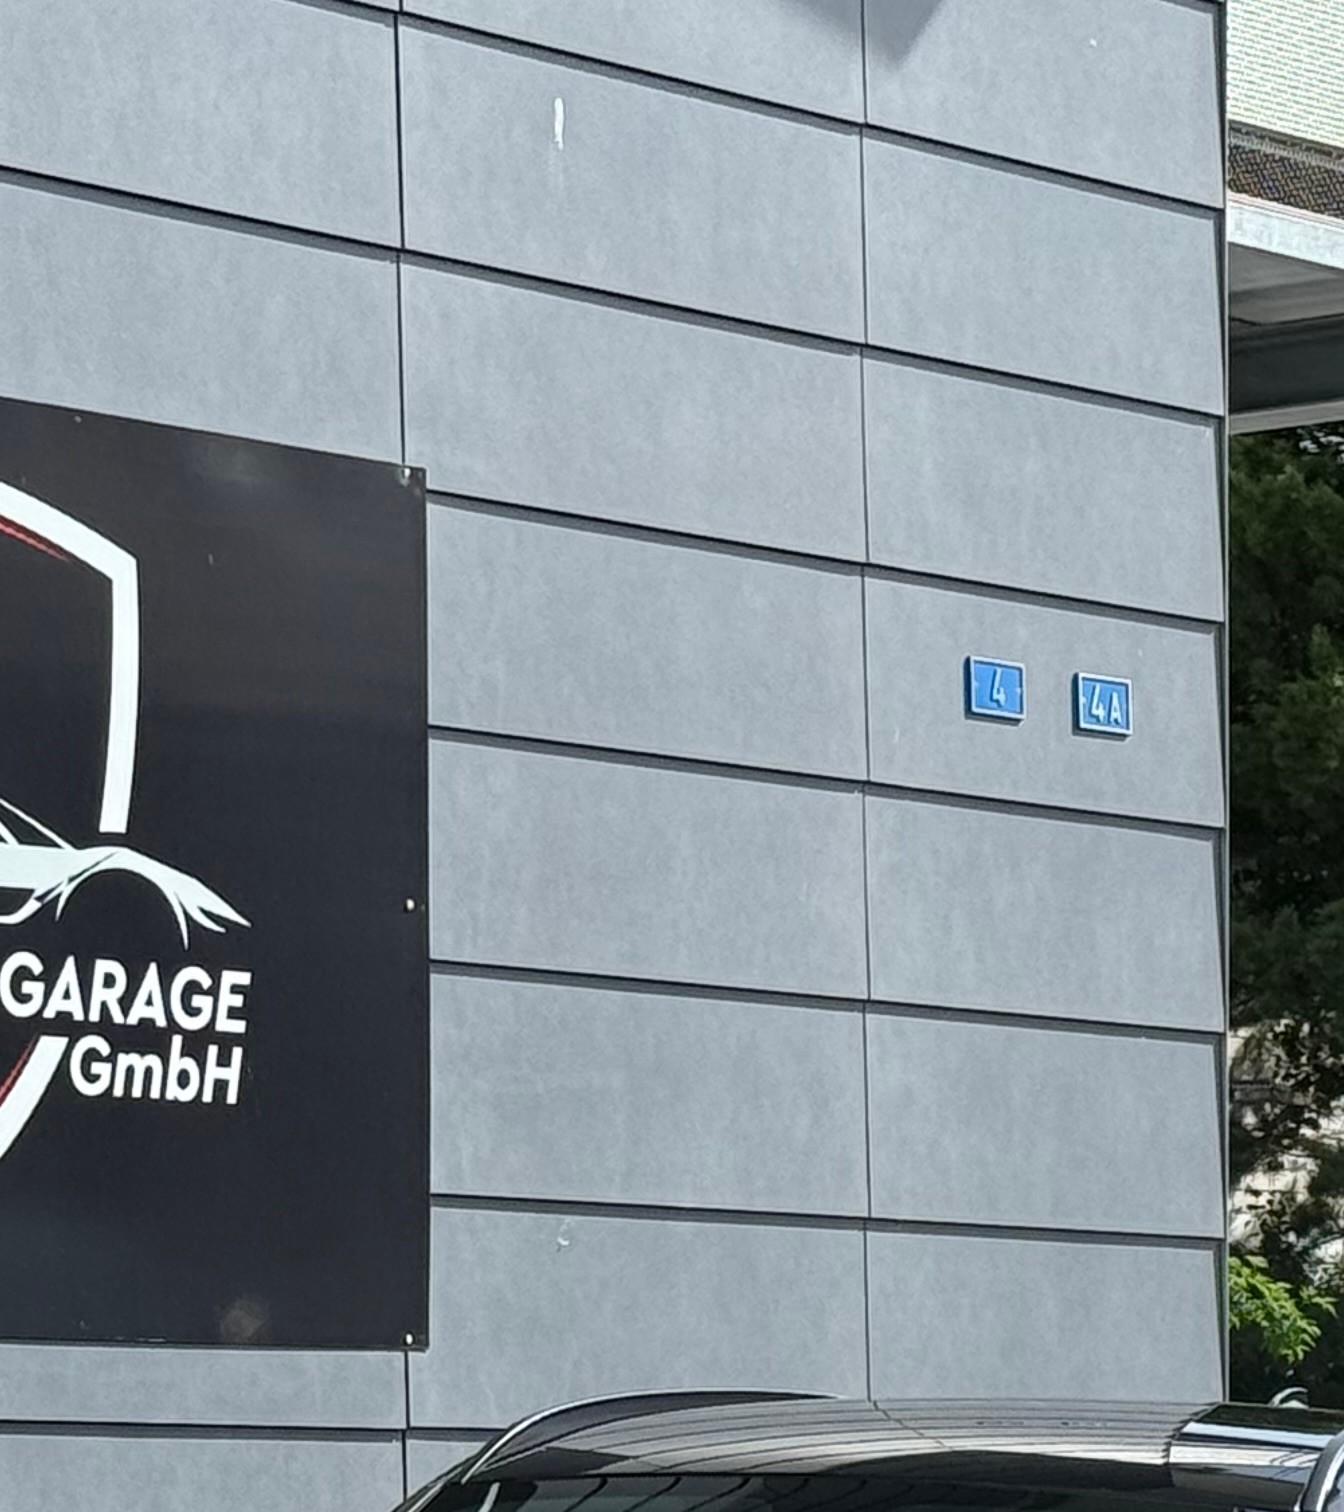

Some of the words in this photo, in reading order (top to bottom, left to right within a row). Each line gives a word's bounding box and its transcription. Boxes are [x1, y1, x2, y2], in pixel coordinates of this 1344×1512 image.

[992, 667, 1007, 707] 4
[1090, 683, 1123, 725] 4A
[69, 1033, 244, 1106] GmbH
